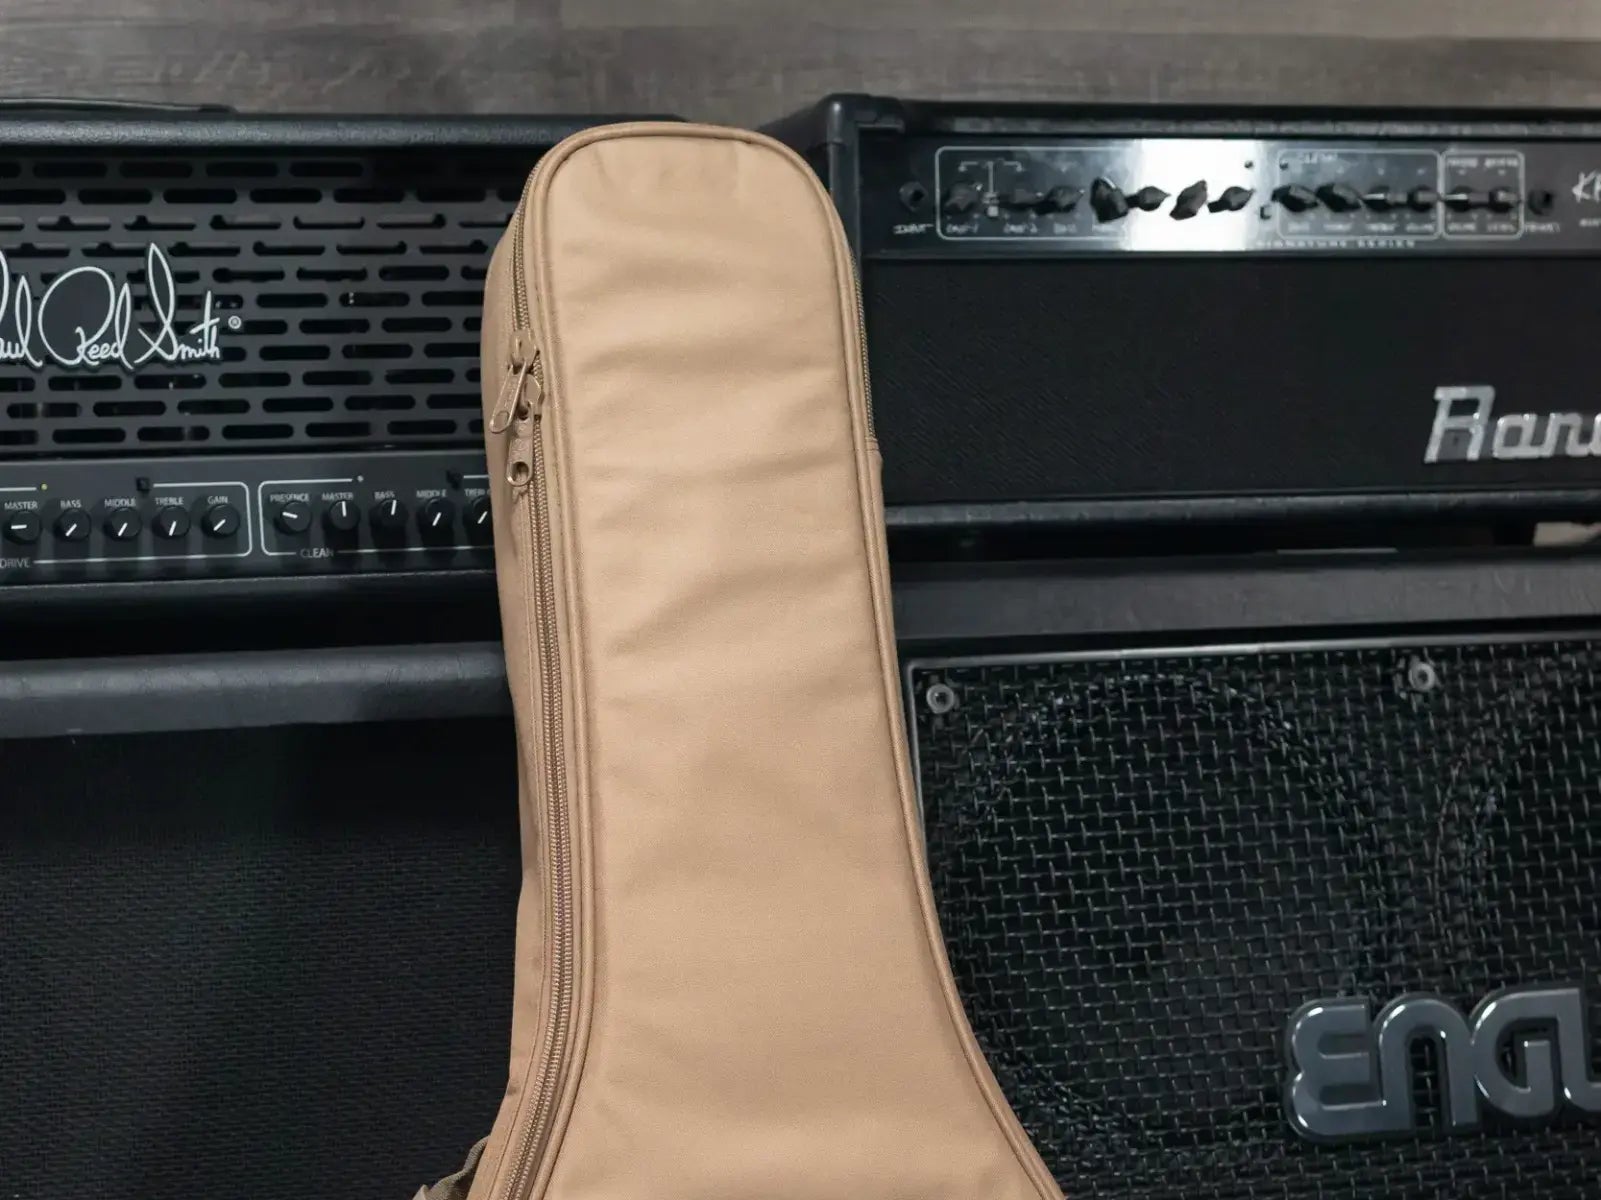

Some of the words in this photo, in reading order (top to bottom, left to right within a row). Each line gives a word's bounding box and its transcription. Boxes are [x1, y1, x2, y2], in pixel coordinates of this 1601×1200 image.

[134, 243, 221, 364] Smith
[1424, 385, 1601, 464] Ran
[321, 491, 353, 500] MASTER
[374, 491, 395, 499] BASS
[60, 500, 82, 508] BASS
[104, 498, 137, 507] MIDDLE
[155, 496, 184, 505] TREBLE
[207, 496, 229, 504] GAIN
[4, 501, 38, 510] MASTER
[301, 547, 333, 559] CLEAN
